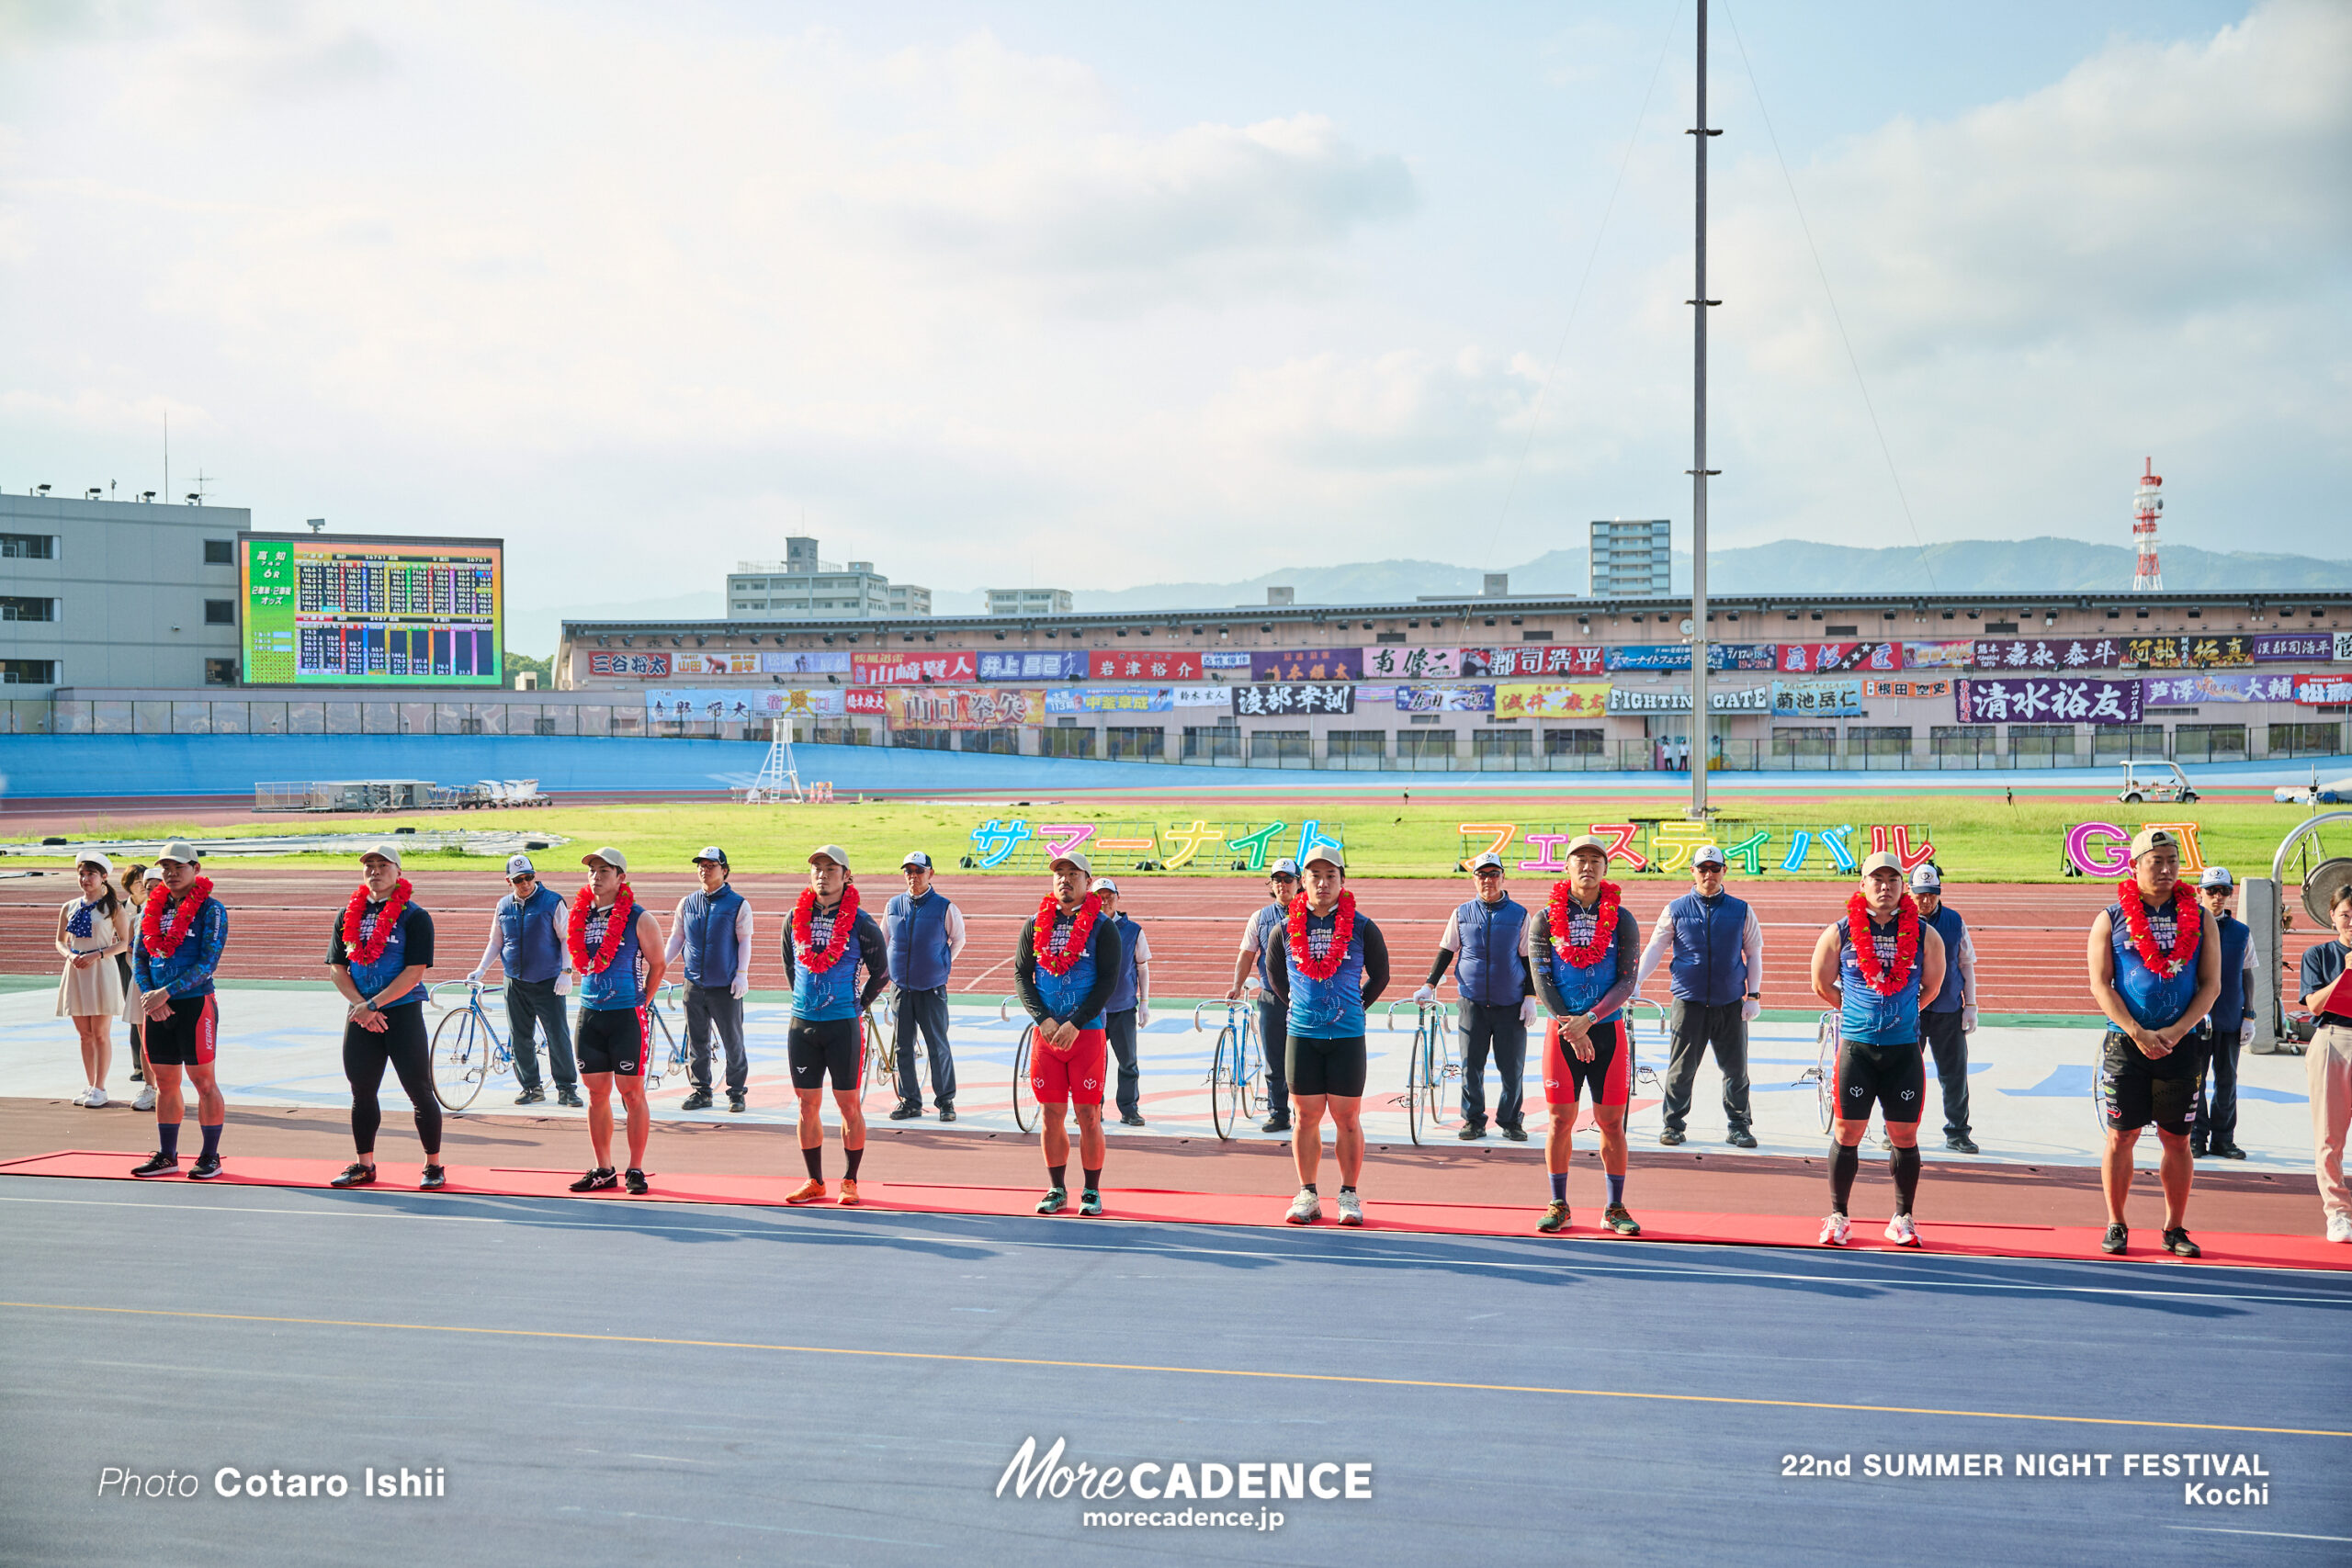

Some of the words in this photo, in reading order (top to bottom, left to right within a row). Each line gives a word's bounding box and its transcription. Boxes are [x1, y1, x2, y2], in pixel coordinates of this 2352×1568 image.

[1492, 647, 1600, 676] 郡司浩平
[2003, 639, 2116, 667] 嘉永泰斗
[2128, 637, 2177, 666] 阿部
[2193, 636, 2247, 665] 拓真
[593, 655, 667, 675] 三谷将太
[678, 660, 702, 672] 山田
[980, 654, 1062, 677] 井上昌己
[1099, 660, 1194, 678] 岩津裕介
[1610, 688, 1692, 709] FIGHTIN
[1713, 685, 1767, 708] GATE
[1777, 691, 1858, 709] 菊池岳仁
[1878, 682, 1946, 696] 根田空史
[2245, 676, 2291, 700] 大輔
[1973, 682, 2126, 720] 清水裕友
[970, 819, 1344, 870] サマーナイト
[1457, 822, 1936, 874] フェスティバル
[205, 1017, 213, 1051] KEIRIN
